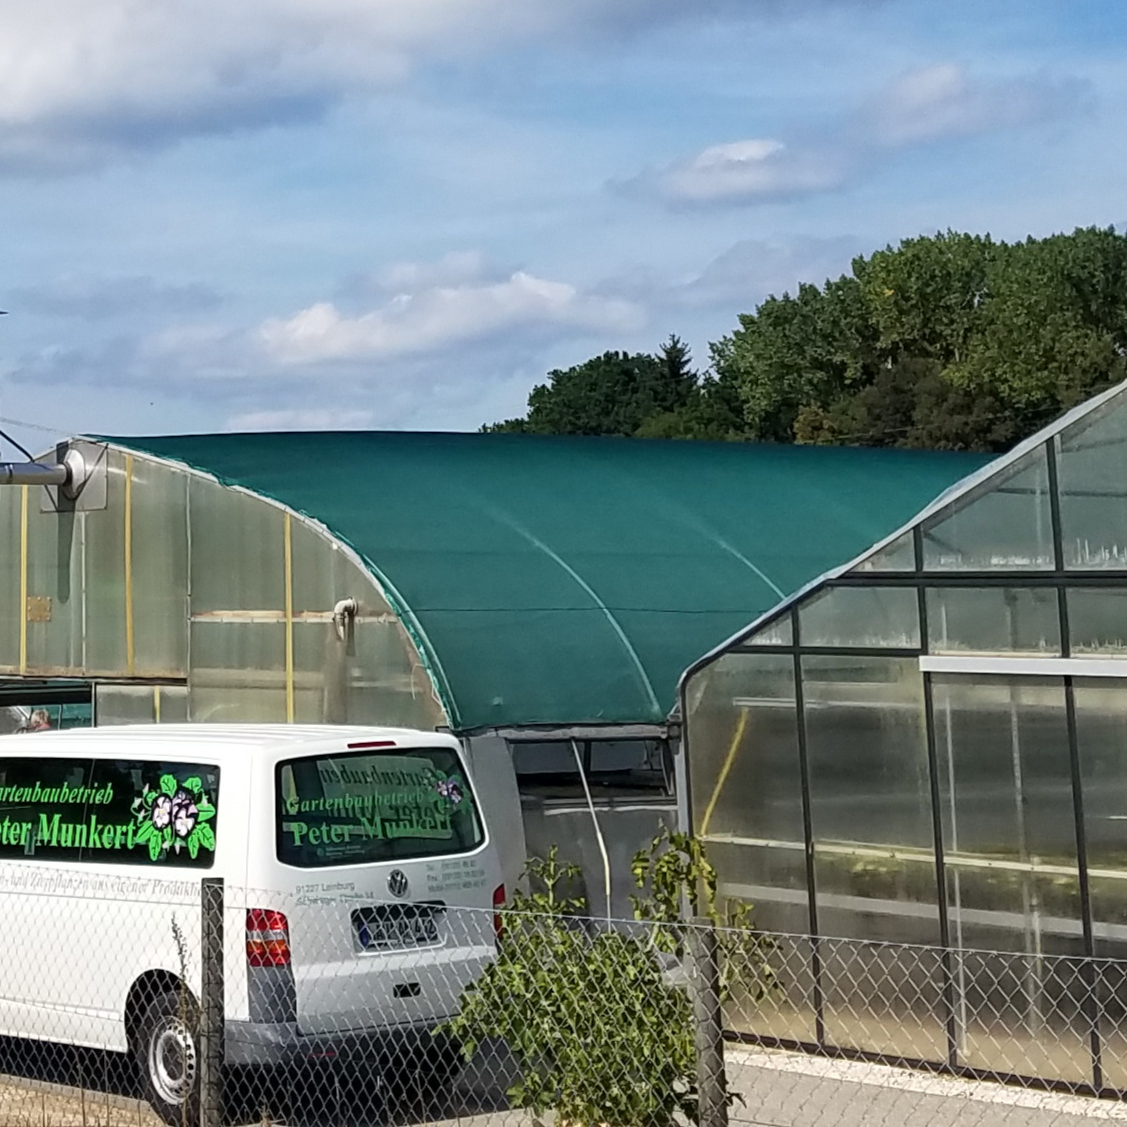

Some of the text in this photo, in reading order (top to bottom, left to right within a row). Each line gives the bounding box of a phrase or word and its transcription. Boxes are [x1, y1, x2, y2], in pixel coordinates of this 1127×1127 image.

[286, 788, 424, 815] Gartenbaubetrieb
[36, 813, 137, 850] Munkert
[292, 814, 453, 846] Peter Munkert
